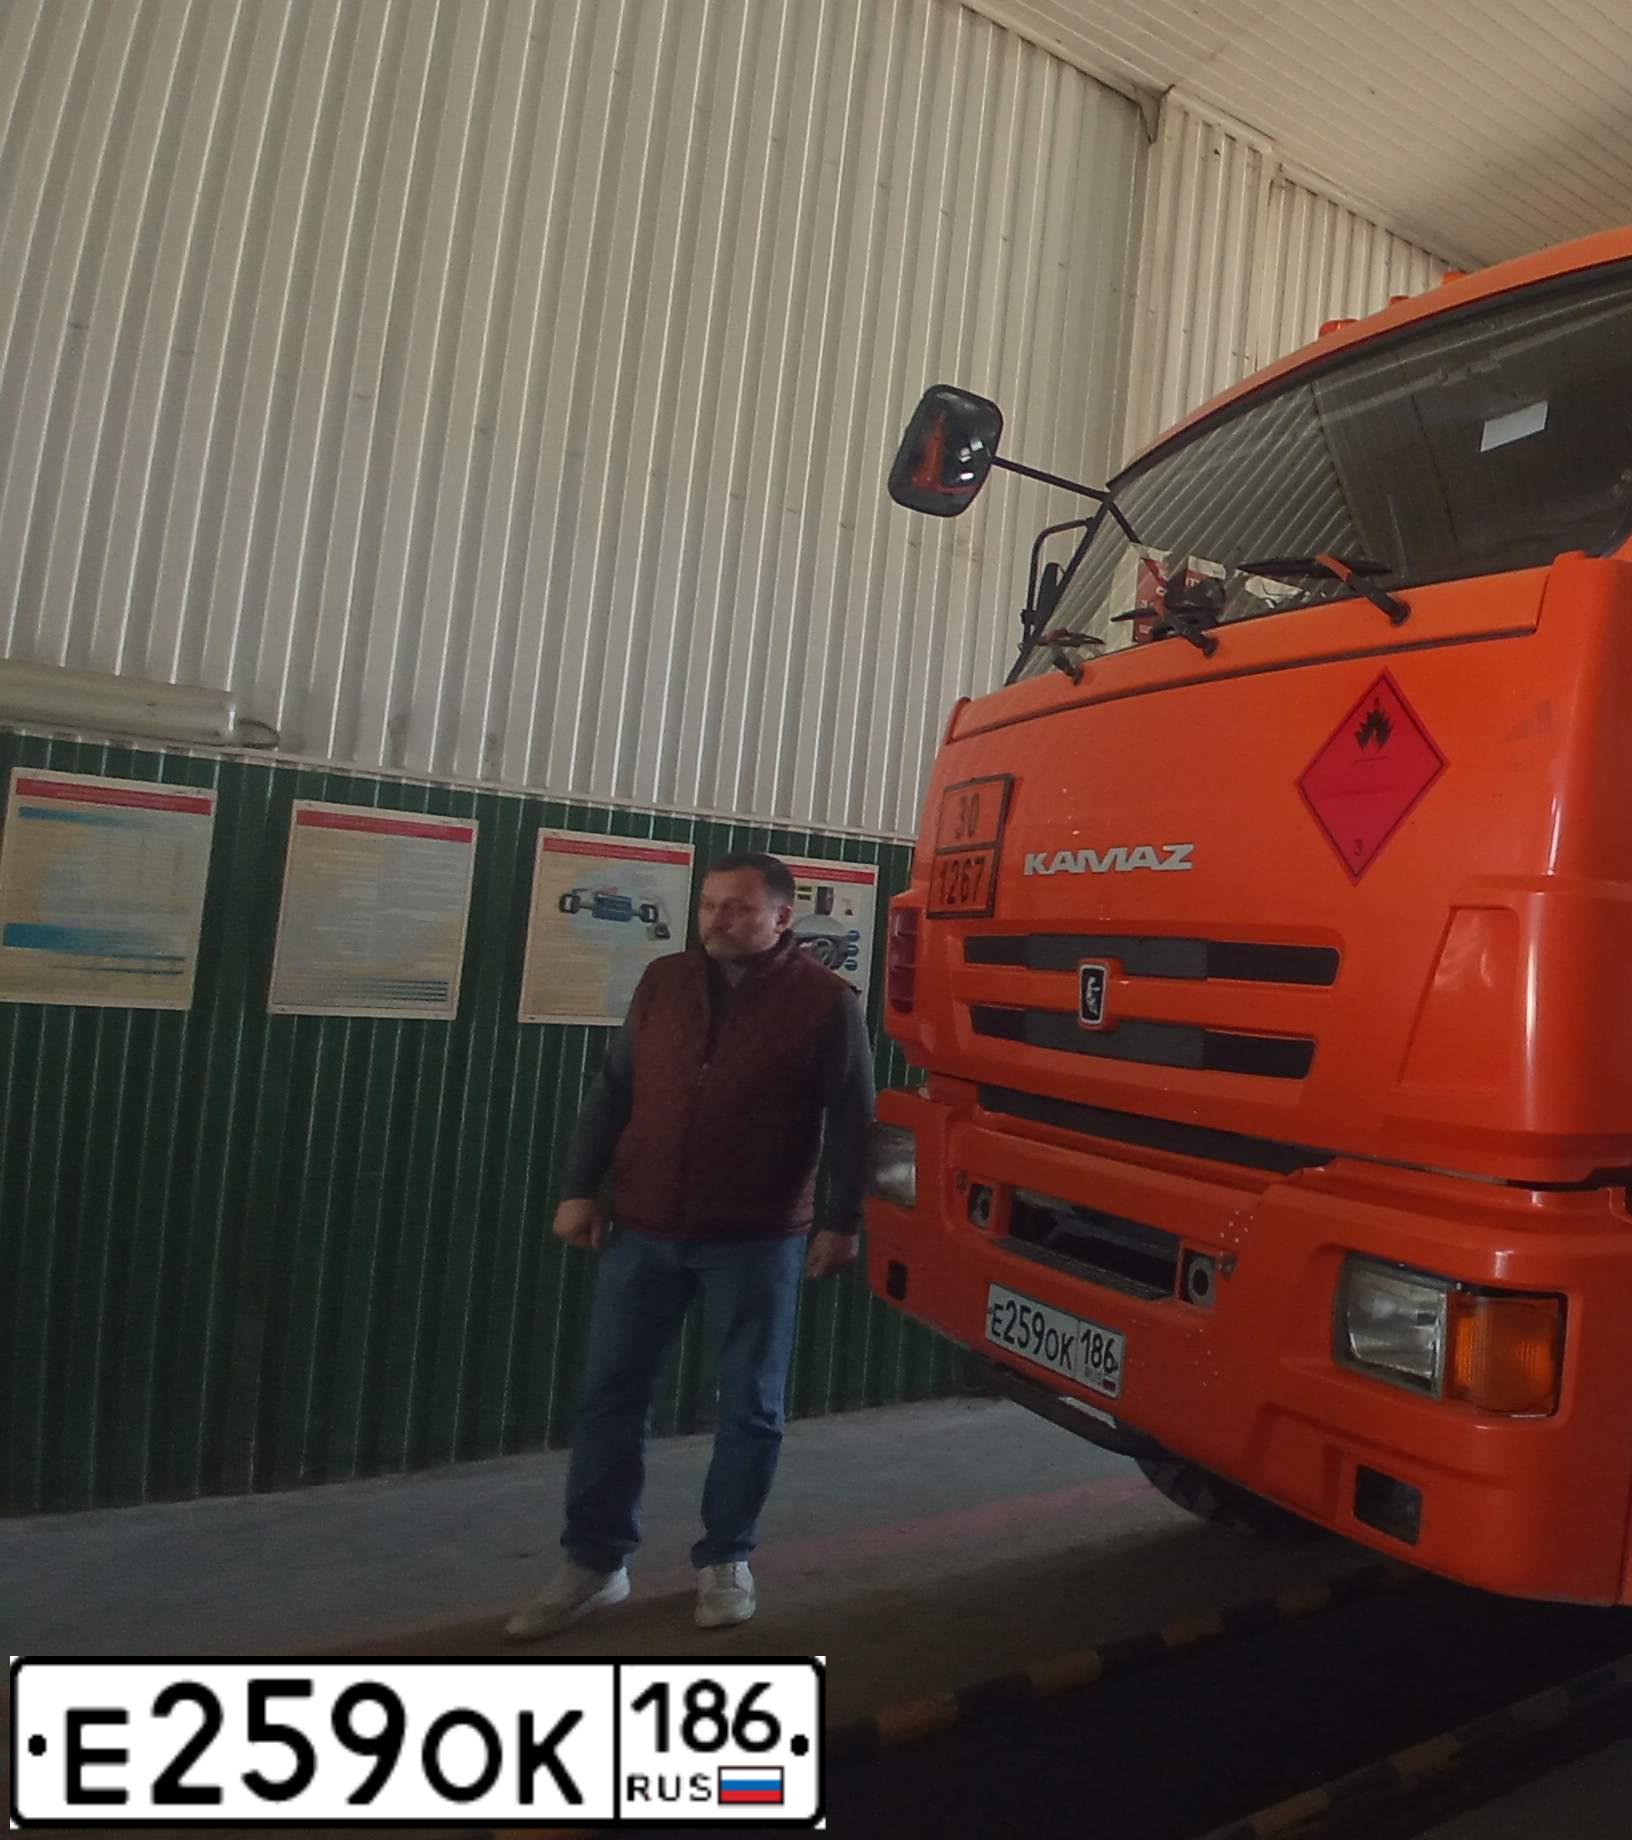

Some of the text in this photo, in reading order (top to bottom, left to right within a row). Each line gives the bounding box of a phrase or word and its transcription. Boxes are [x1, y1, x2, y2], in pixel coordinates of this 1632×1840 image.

[954, 792, 980, 840] 30
[939, 856, 986, 905] 1267
[1024, 844, 1194, 876] KAMAZ
[1081, 1329, 1118, 1374] 186
